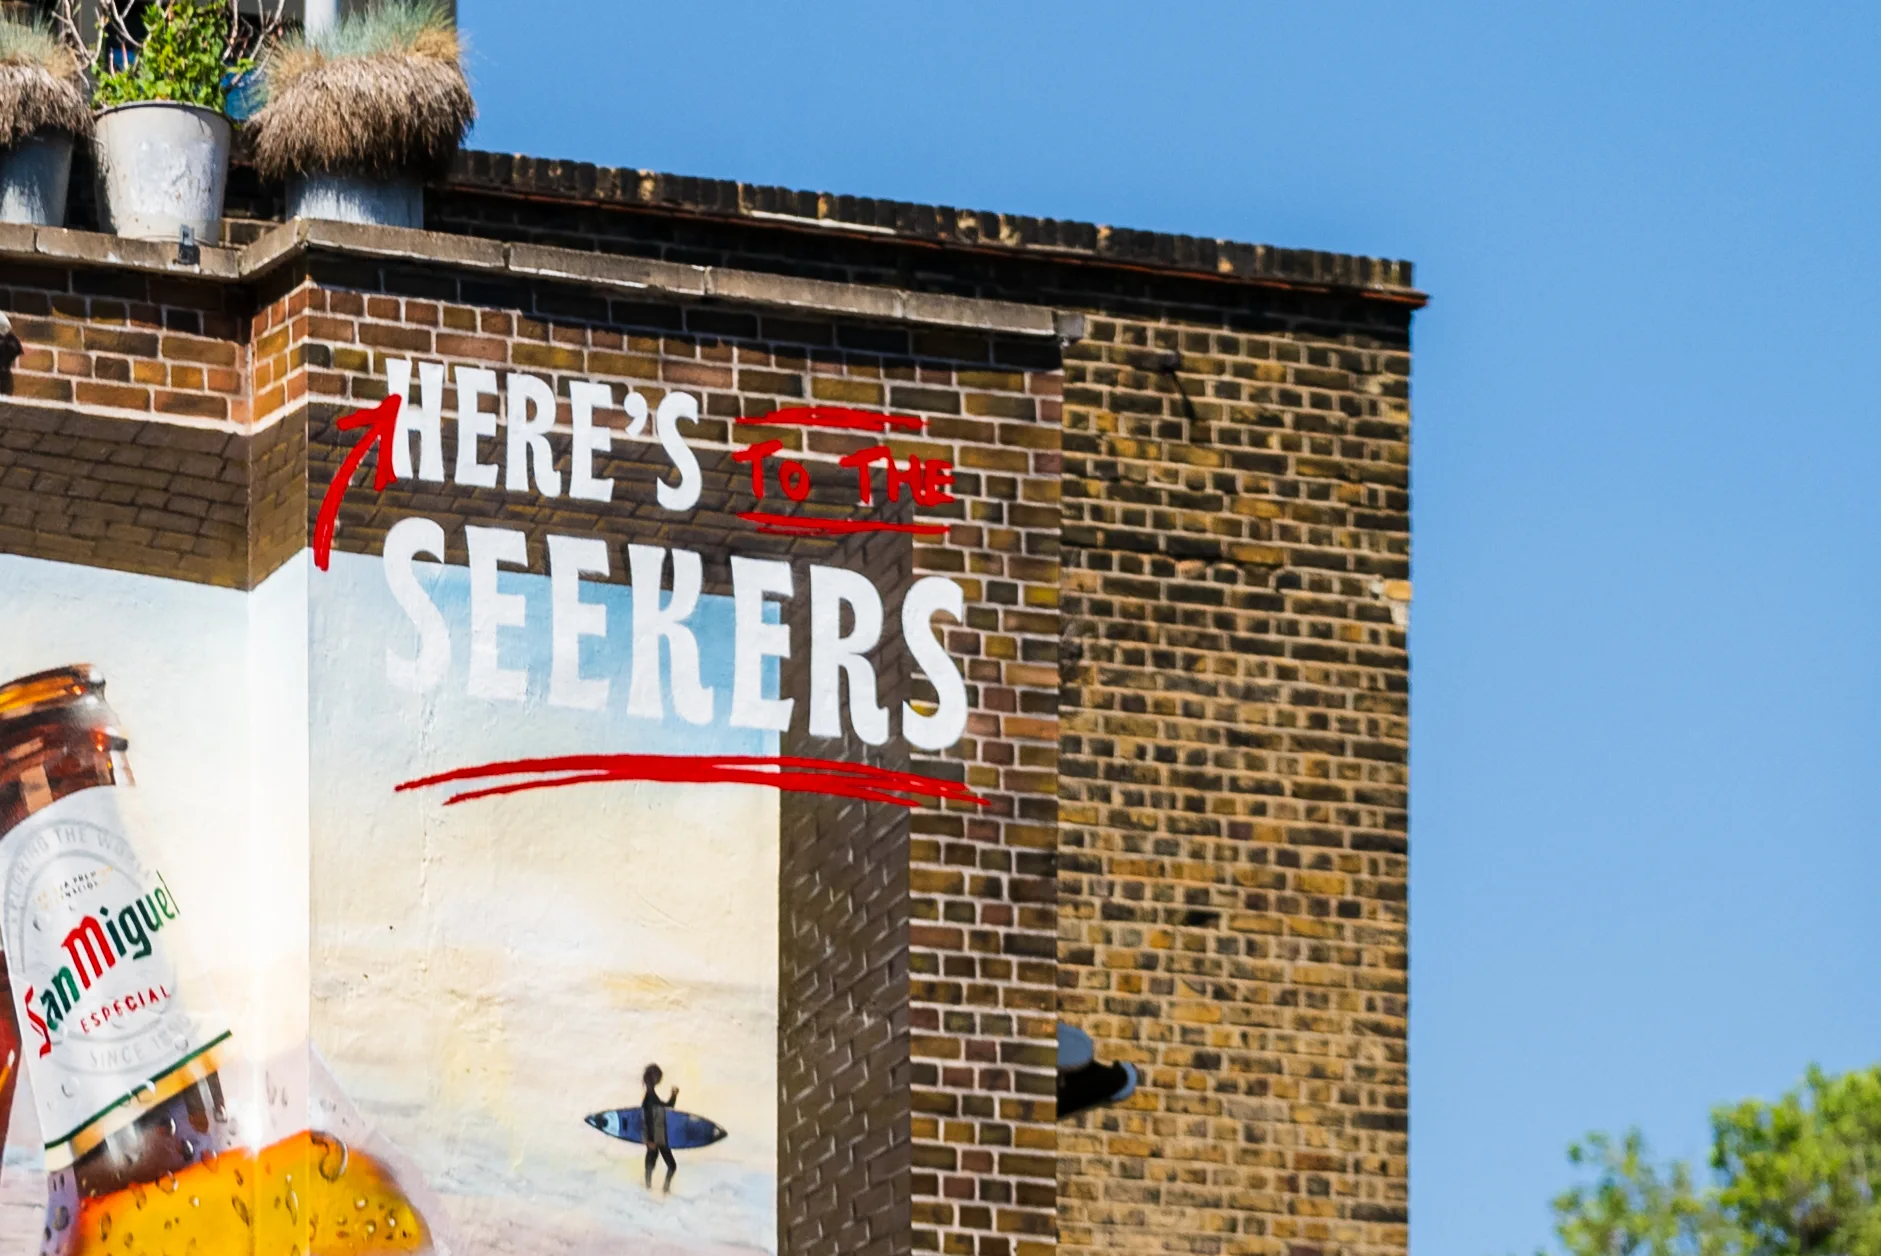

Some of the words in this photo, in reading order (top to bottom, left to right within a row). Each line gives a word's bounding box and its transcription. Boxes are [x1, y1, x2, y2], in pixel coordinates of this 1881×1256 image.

[384, 358, 702, 511] HERE'S
[732, 440, 810, 502] TO
[839, 444, 957, 507] THE
[382, 517, 969, 751] SEEKERS
[80, 983, 172, 1035] ESPECIAL
